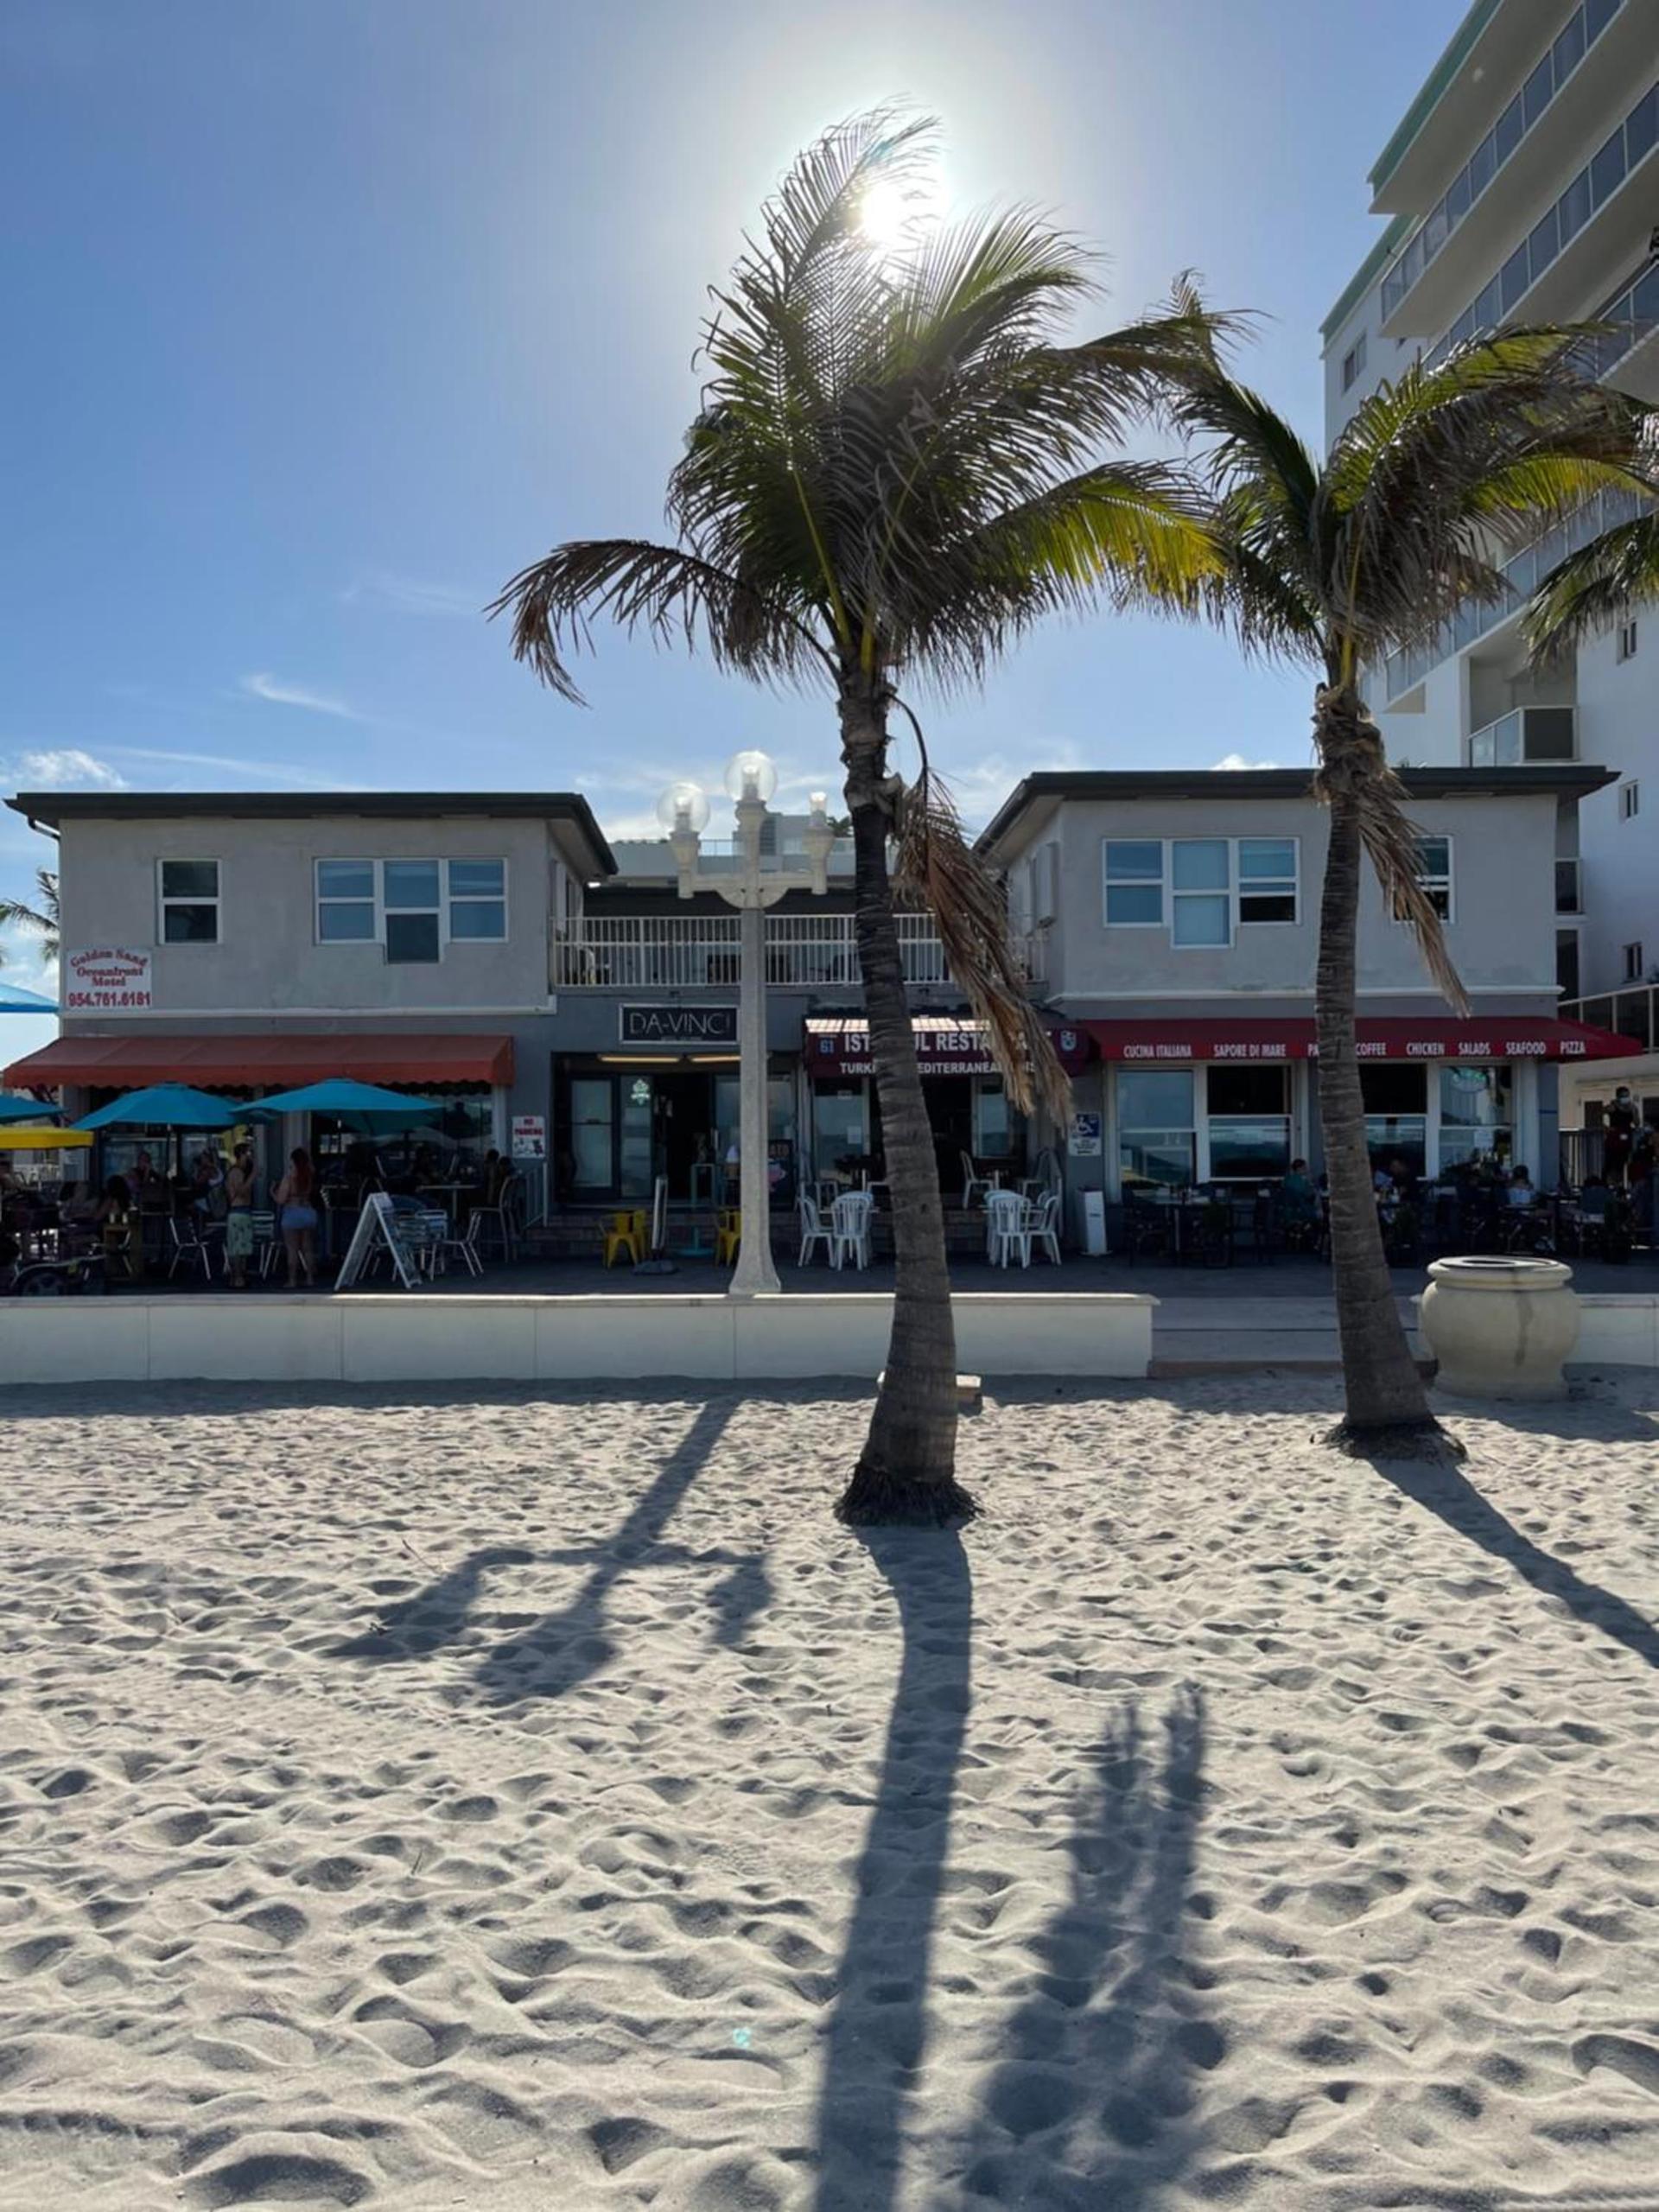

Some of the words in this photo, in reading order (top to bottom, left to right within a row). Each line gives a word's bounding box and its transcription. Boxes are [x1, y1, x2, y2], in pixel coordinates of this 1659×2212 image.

[71, 950, 112, 967] Golden
[116, 949, 148, 967] Sand
[77, 966, 143, 977] Oceanfront
[92, 976, 125, 987] Motel
[629, 1012, 731, 1034] DA-VINCI
[1123, 1045, 1154, 1058] CUCINA
[1156, 1044, 1192, 1058] ITALIANA
[1213, 1044, 1246, 1058] SAPORE
[1249, 1044, 1260, 1057] DI
[1262, 1044, 1286, 1057] MARE
[1355, 1043, 1386, 1056] COFFEE
[1406, 1042, 1445, 1056] CHICKEN
[1459, 1042, 1491, 1055] SALADS
[1506, 1041, 1547, 1055] SEAFOOD
[1560, 1041, 1586, 1054] PIZZA
